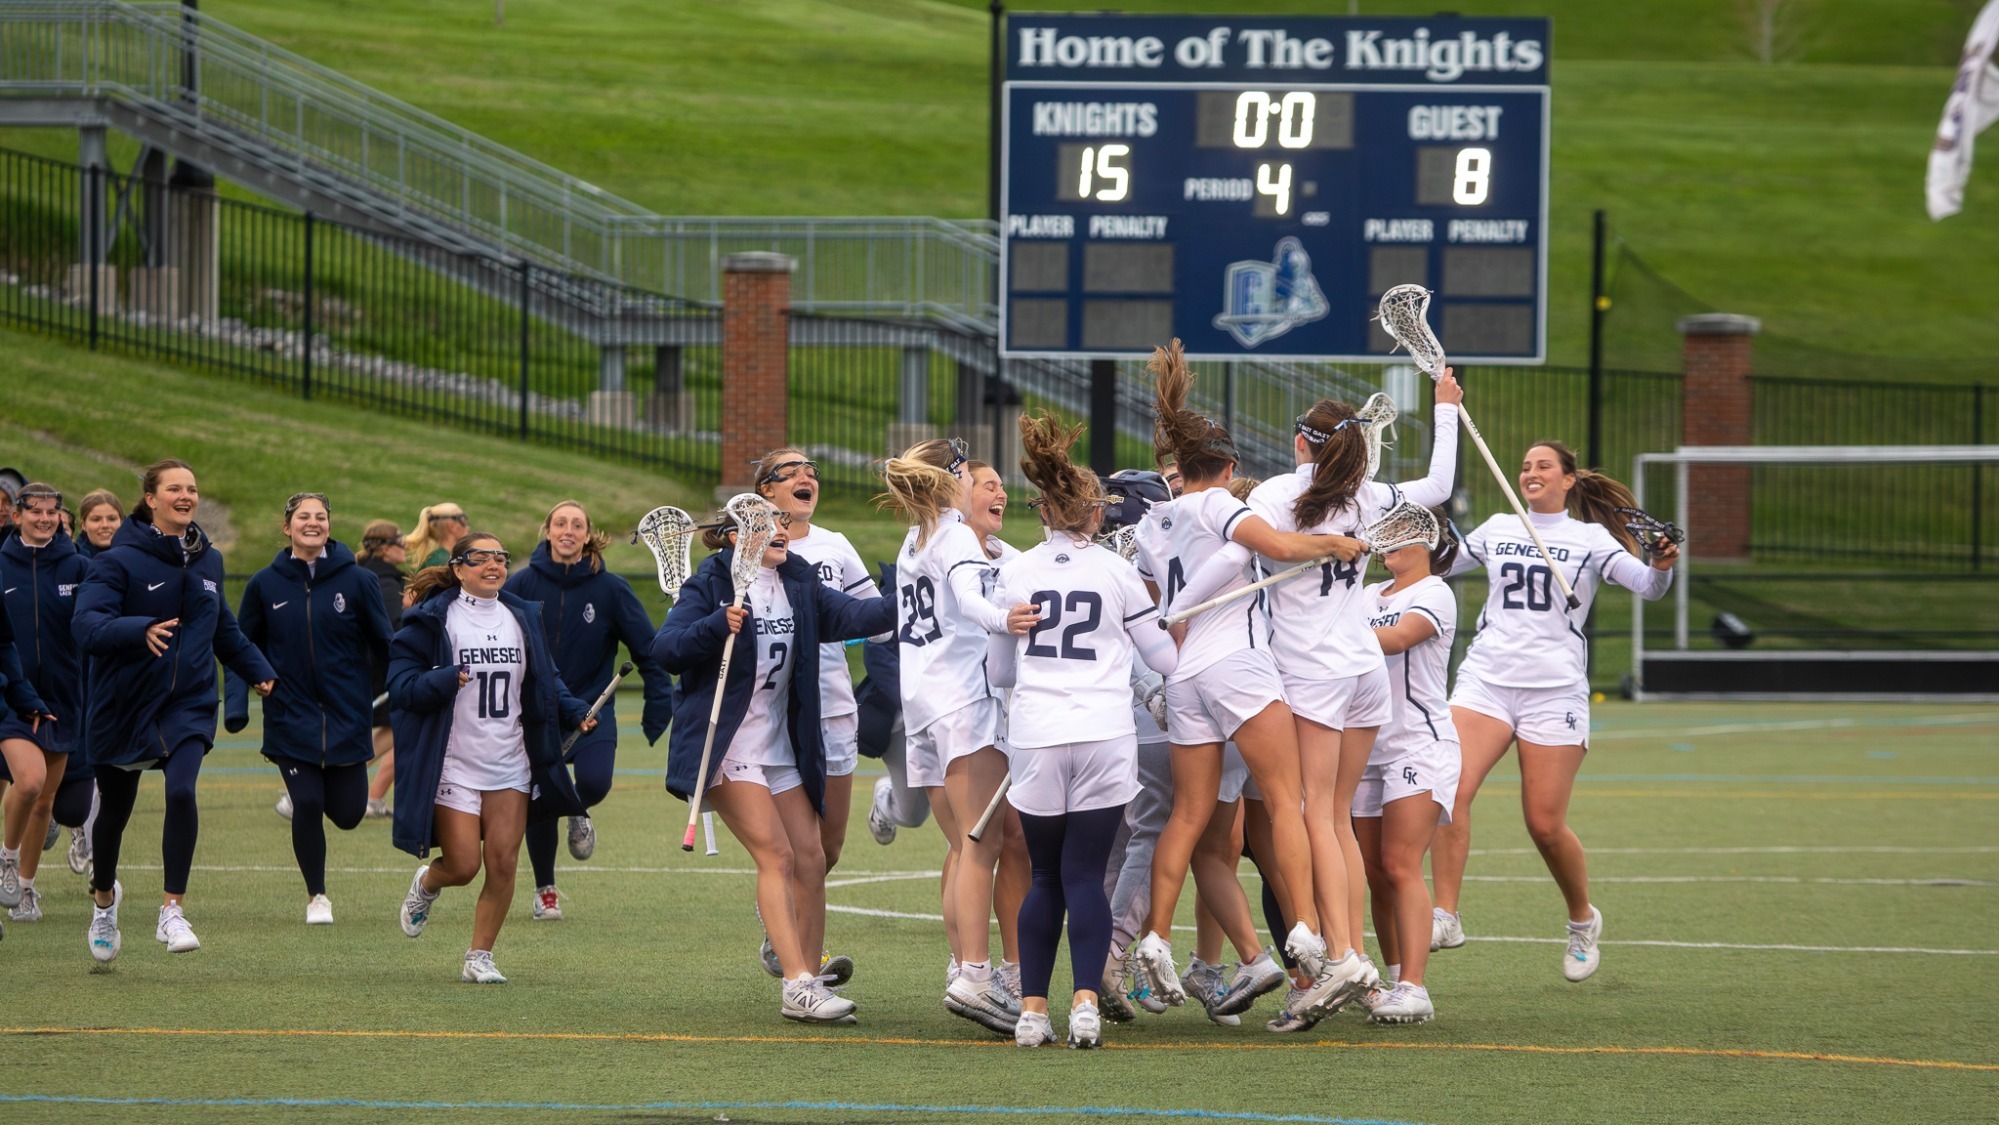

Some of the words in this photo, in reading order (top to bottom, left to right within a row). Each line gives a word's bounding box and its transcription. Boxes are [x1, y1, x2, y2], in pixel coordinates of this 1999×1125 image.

[1018, 27, 1164, 68] Home
[1174, 27, 1232, 68] of
[1237, 29, 1334, 69] The
[1344, 27, 1544, 82] Knights
[1032, 101, 1158, 137] KNIGHTS
[1407, 105, 1503, 140] GUEST
[1078, 144, 1130, 200] 15
[1184, 178, 1254, 200] PERIOD
[1256, 163, 1292, 215] 4
[1452, 148, 1491, 205] 8
[1008, 215, 1074, 238] PLAYER
[1089, 216, 1168, 239] PENALTY
[1364, 219, 1434, 242] PLAYER
[1448, 220, 1529, 242] PENALTY
[1312, 430, 1331, 440] GAIT
[1501, 562, 1554, 611] 20
[755, 616, 795, 636] ENESE
[900, 575, 943, 647] 29
[1024, 590, 1103, 661] 22
[459, 647, 522, 665] GENESEO
[761, 642, 788, 690] 2
[477, 671, 511, 718] 10
